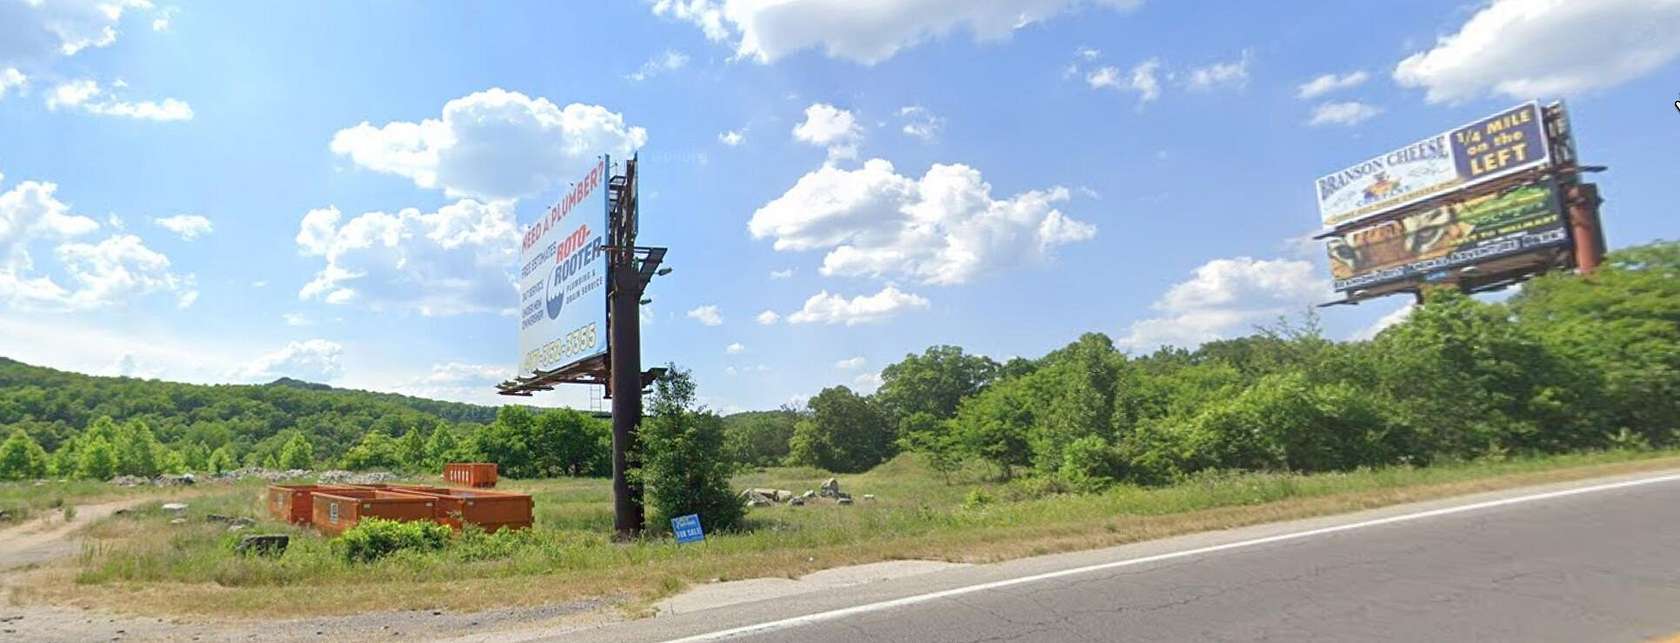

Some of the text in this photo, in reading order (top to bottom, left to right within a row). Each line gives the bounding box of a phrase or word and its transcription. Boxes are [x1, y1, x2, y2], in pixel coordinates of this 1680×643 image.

[1456, 110, 1530, 145] 1/4 MILE
[1467, 130, 1523, 157] on the
[1319, 158, 1383, 201] BRANSON
[1386, 135, 1449, 167] CHEESE
[1470, 143, 1526, 177] LEFT
[522, 160, 604, 249] NEED A PLUMBER?
[556, 223, 592, 264] ROTO-
[554, 236, 602, 287] ROOTER
[566, 273, 590, 293] PLUMBING
[581, 276, 603, 296] SERVICE
